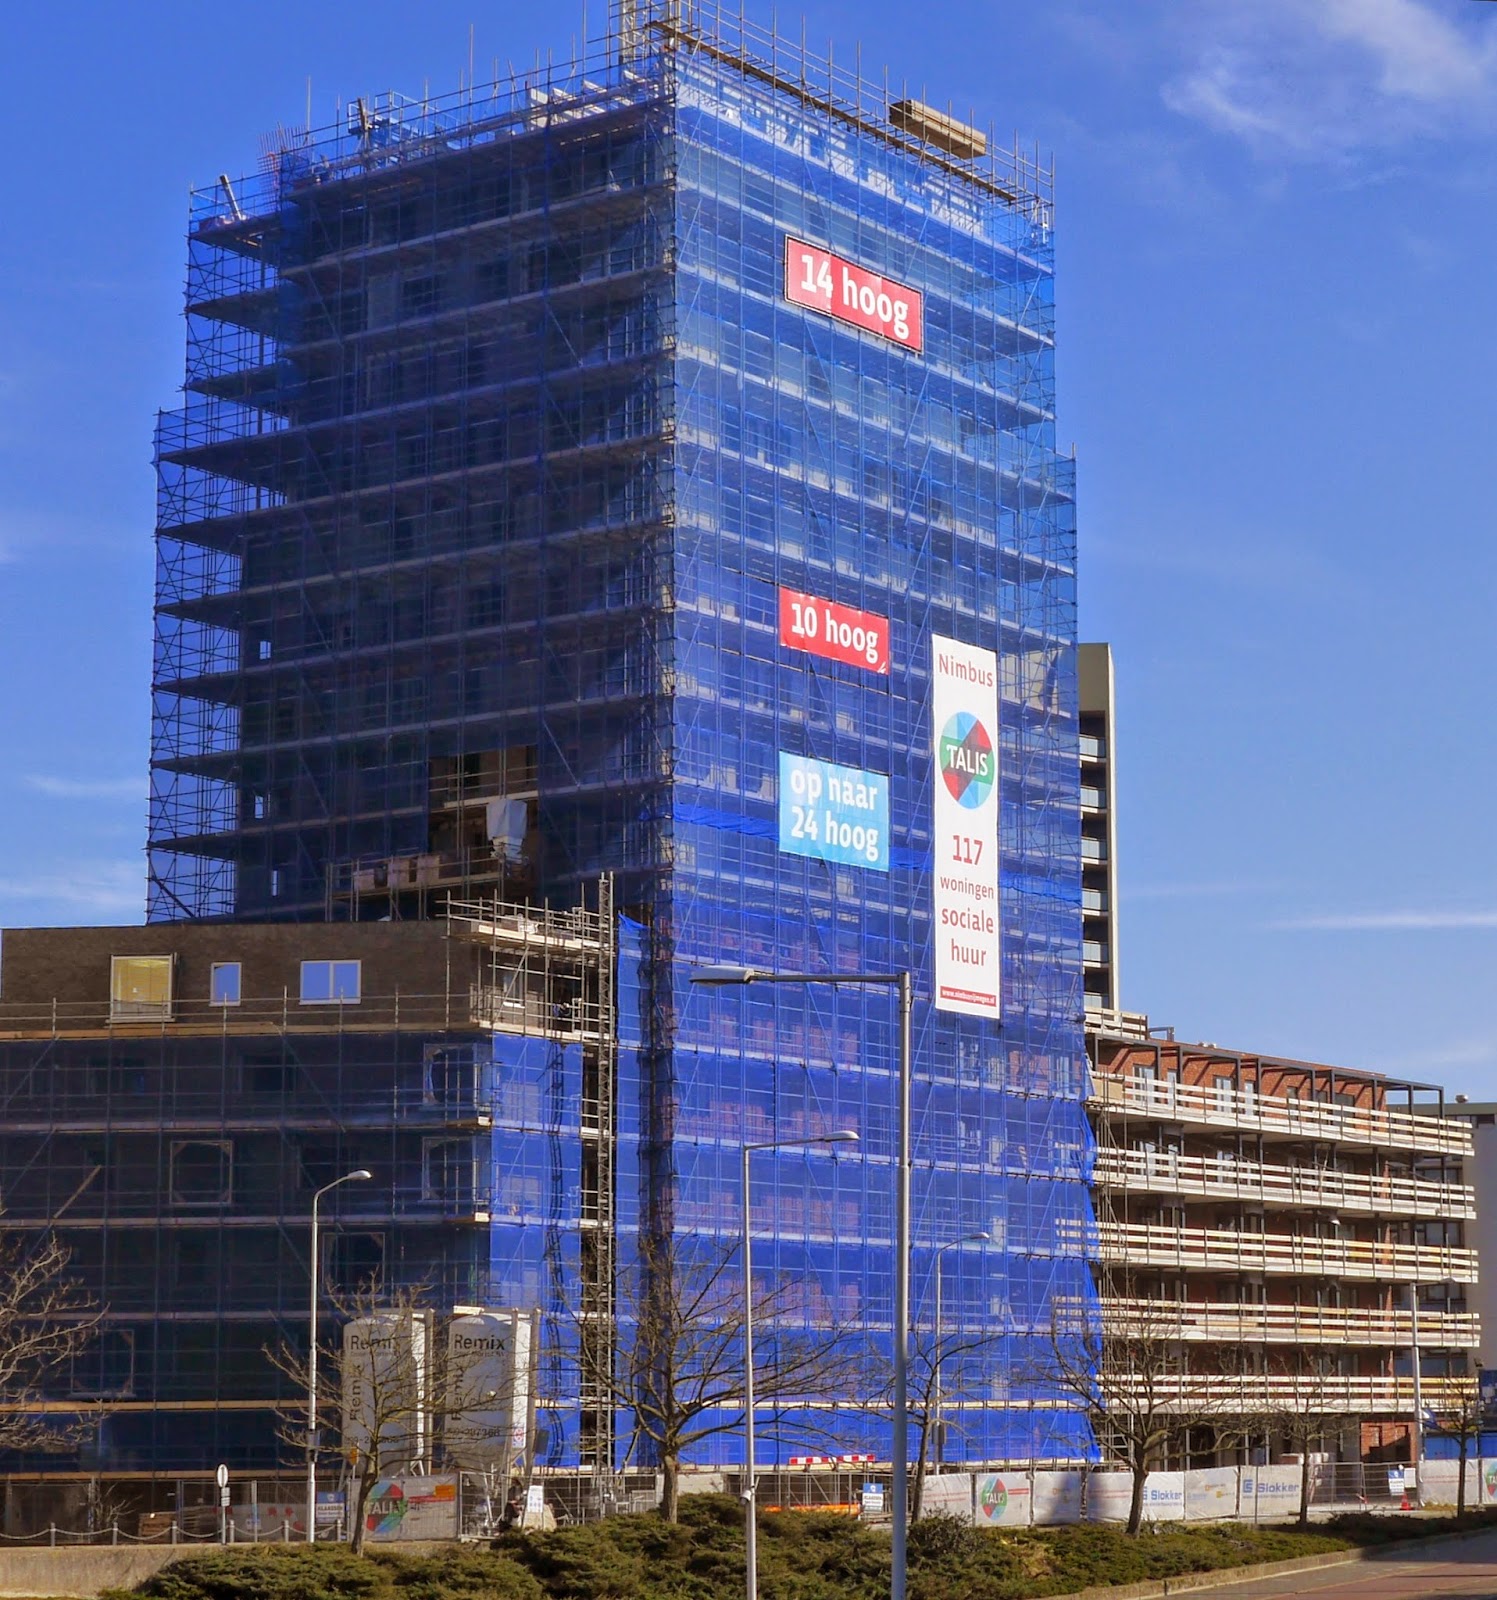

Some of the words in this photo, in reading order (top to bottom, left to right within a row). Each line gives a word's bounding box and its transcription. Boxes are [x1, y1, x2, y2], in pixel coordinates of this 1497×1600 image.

[801, 254, 833, 299] 14
[842, 266, 909, 340] hoog
[791, 603, 817, 638] 10
[825, 609, 878, 663] hoog
[938, 653, 993, 687] Nimbus
[946, 744, 988, 776] TALIS
[790, 769, 822, 807] op
[828, 777, 878, 810] naar
[791, 806, 818, 841] 24
[825, 810, 878, 862] hoog
[952, 835, 983, 866] 117
[940, 876, 994, 901] woningen
[941, 907, 994, 934] sociale
[950, 938, 987, 966] huur
[455, 1334, 505, 1350] Remix
[1151, 1489, 1183, 1501] Slokker
[1258, 1482, 1299, 1493] Slokker
